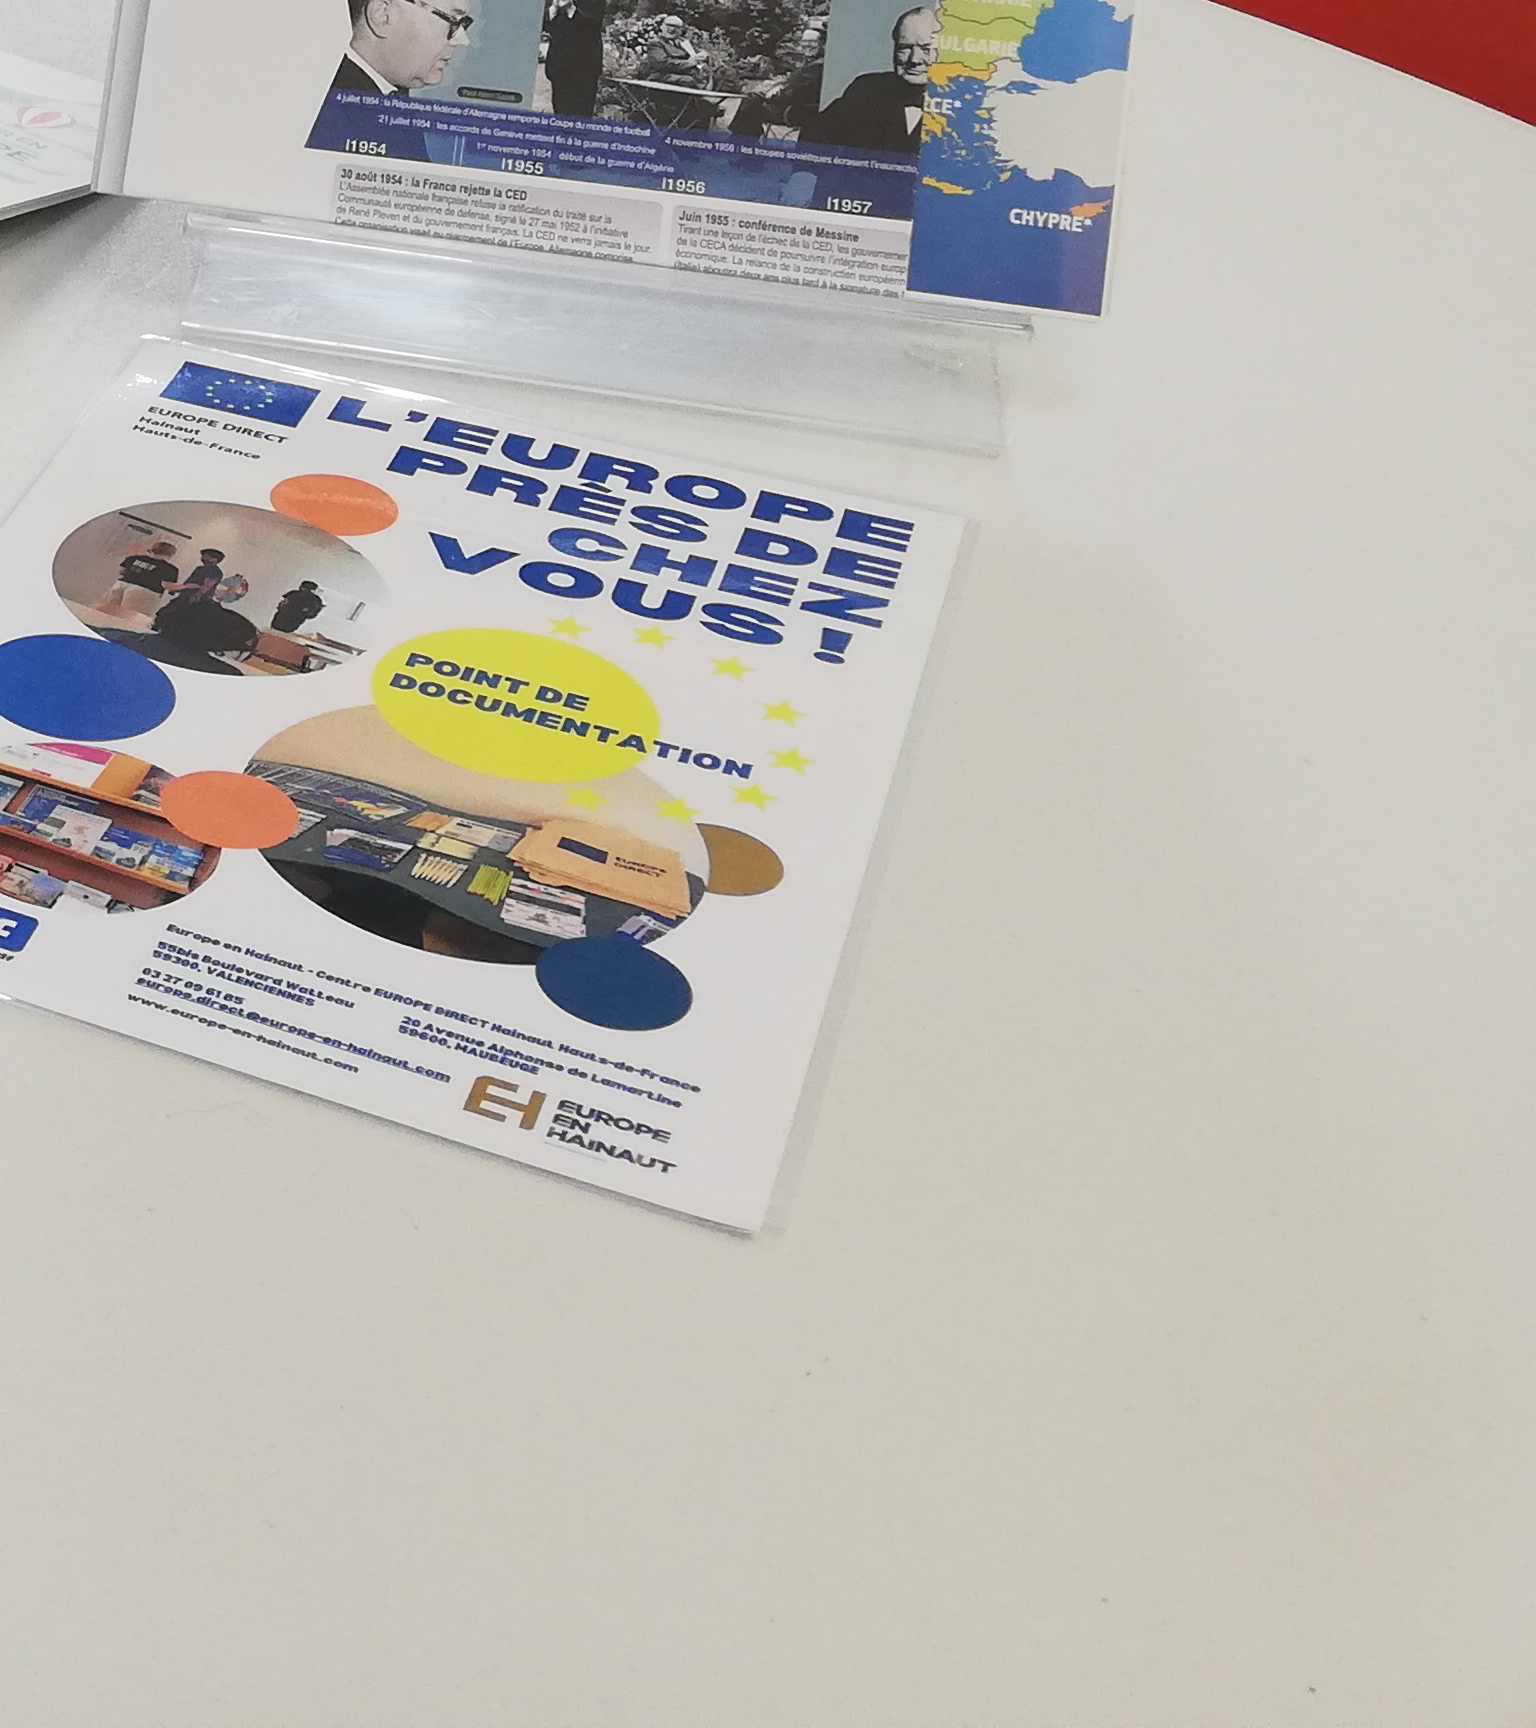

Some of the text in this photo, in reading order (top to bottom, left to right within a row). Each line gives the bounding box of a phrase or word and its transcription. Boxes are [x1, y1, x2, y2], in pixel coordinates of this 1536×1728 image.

[355, 169, 380, 184] août
[410, 176, 421, 188] la
[422, 178, 457, 193] France
[459, 182, 491, 197] rejette
[493, 187, 503, 198] la
[505, 188, 528, 201] CED
[679, 210, 859, 243] Juin 1955 conférence de Messine
[132, 424, 260, 460] Hauts-de-France
[138, 415, 201, 437] Hainaut
[147, 406, 289, 446] EUROPE DIRECT
[327, 396, 915, 553] L'EUROPE
[387, 445, 902, 589] PRÈS DE
[428, 531, 853, 664] VOUS !
[548, 526, 891, 629] CHEZ
[405, 652, 590, 712] POINT DE
[389, 673, 754, 779] DOCUMENTATION
[142, 967, 161, 980] 03
[162, 973, 183, 986] 27
[184, 979, 203, 992] 09
[205, 986, 222, 998] 61
[201, 954, 283, 987] Boulevard
[286, 979, 356, 1009] Watteau
[206, 965, 316, 1007] VALENCIENNES
[127, 993, 359, 1074] www.europe-en-hainaut.com
[135, 977, 451, 1084] europe.direct@europe-en-hainaut.com
[166, 924, 701, 1093] Europe en Hainaut Centre EUROPE DIRECT Hainaut Hauts-de-France
[401, 1015, 682, 1109] 20 Avenue Alphonse de Lamartine
[454, 1042, 540, 1075] MAUBEUGE
[552, 1113, 591, 1134] EN
[557, 1099, 672, 1144] EUROPE
[546, 1126, 678, 1173] HAINAUT
